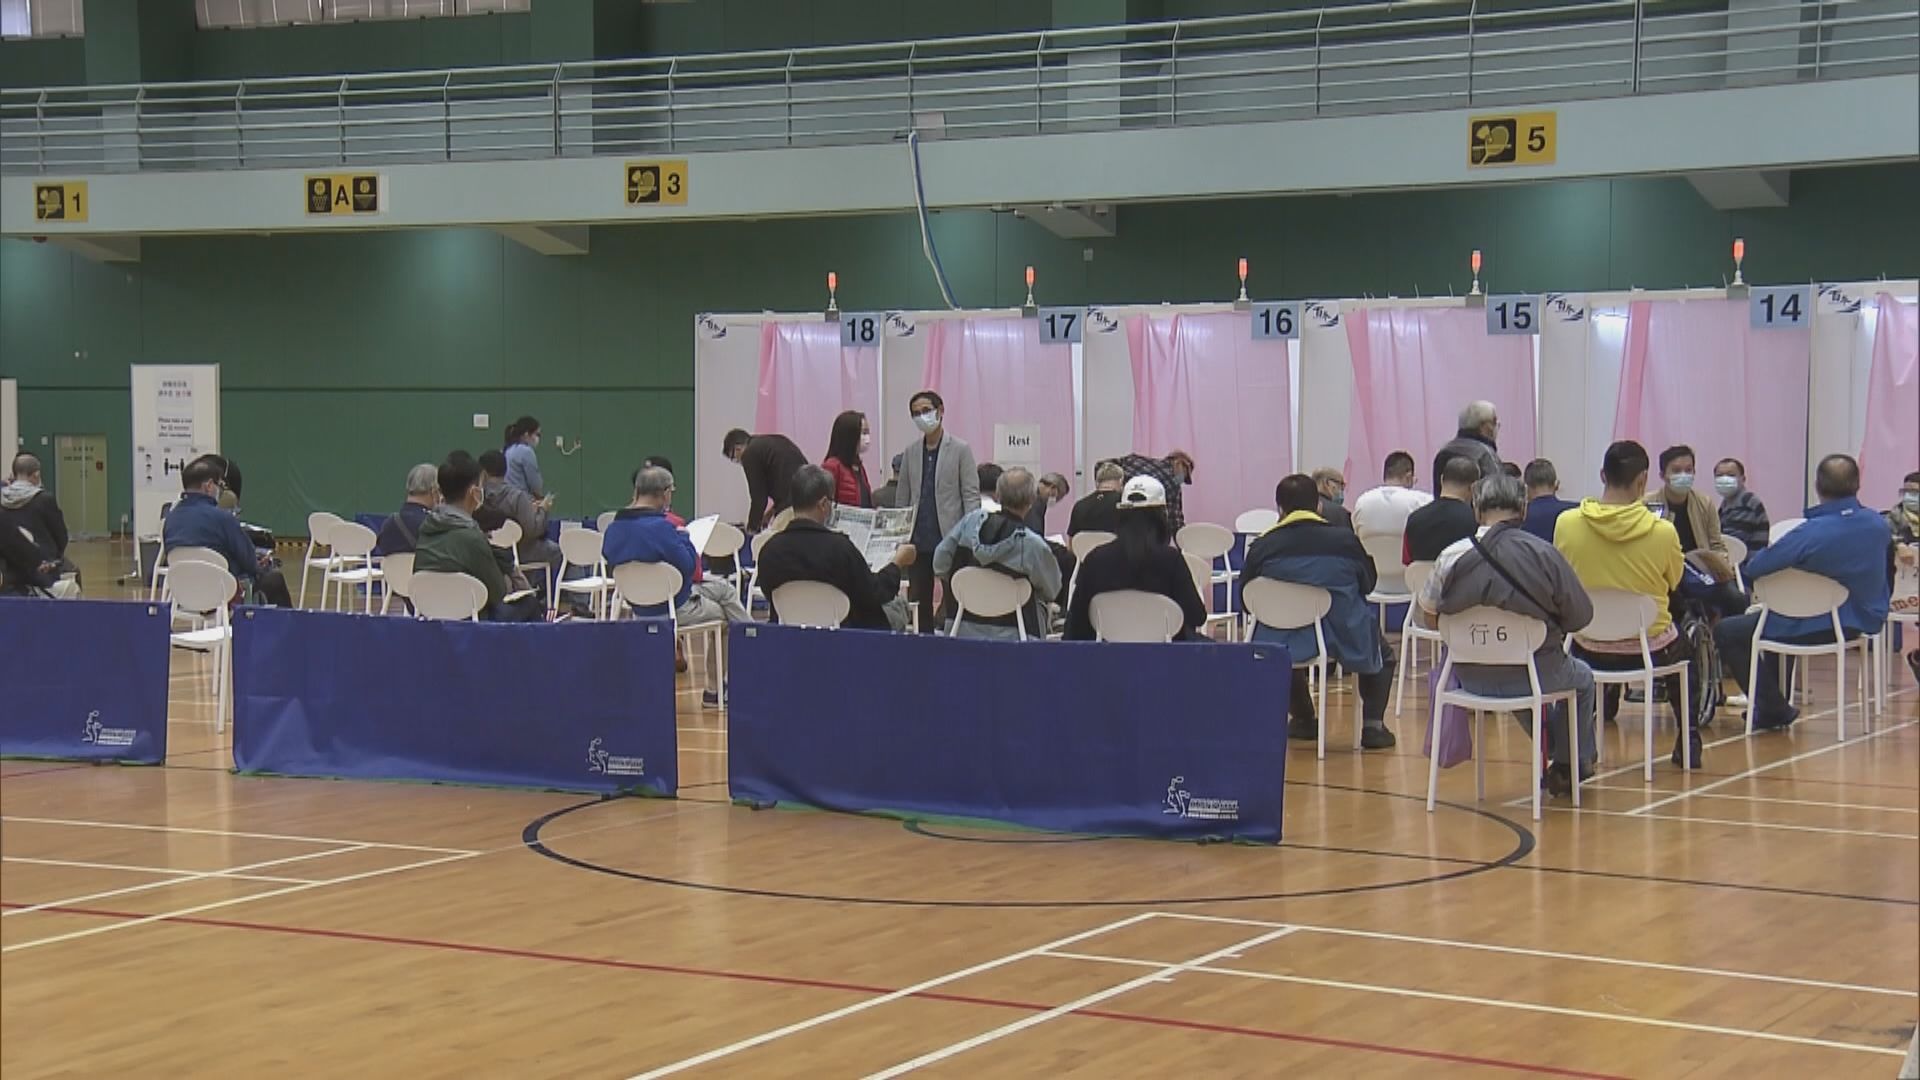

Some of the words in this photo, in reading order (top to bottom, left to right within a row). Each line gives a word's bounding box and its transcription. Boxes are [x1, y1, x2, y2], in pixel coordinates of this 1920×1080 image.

[1527, 126, 1546, 153] 5
[335, 184, 350, 206] A
[667, 172, 680, 195] 3
[72, 191, 80, 213] 1
[1495, 302, 1532, 330] 15
[1759, 293, 1802, 323] 14
[847, 318, 875, 342] 18
[1045, 314, 1077, 339] 17
[1259, 308, 1293, 335] 16
[1008, 434, 1030, 446] Rest
[1469, 623, 1490, 645] 行
[1496, 625, 1508, 642] 6
